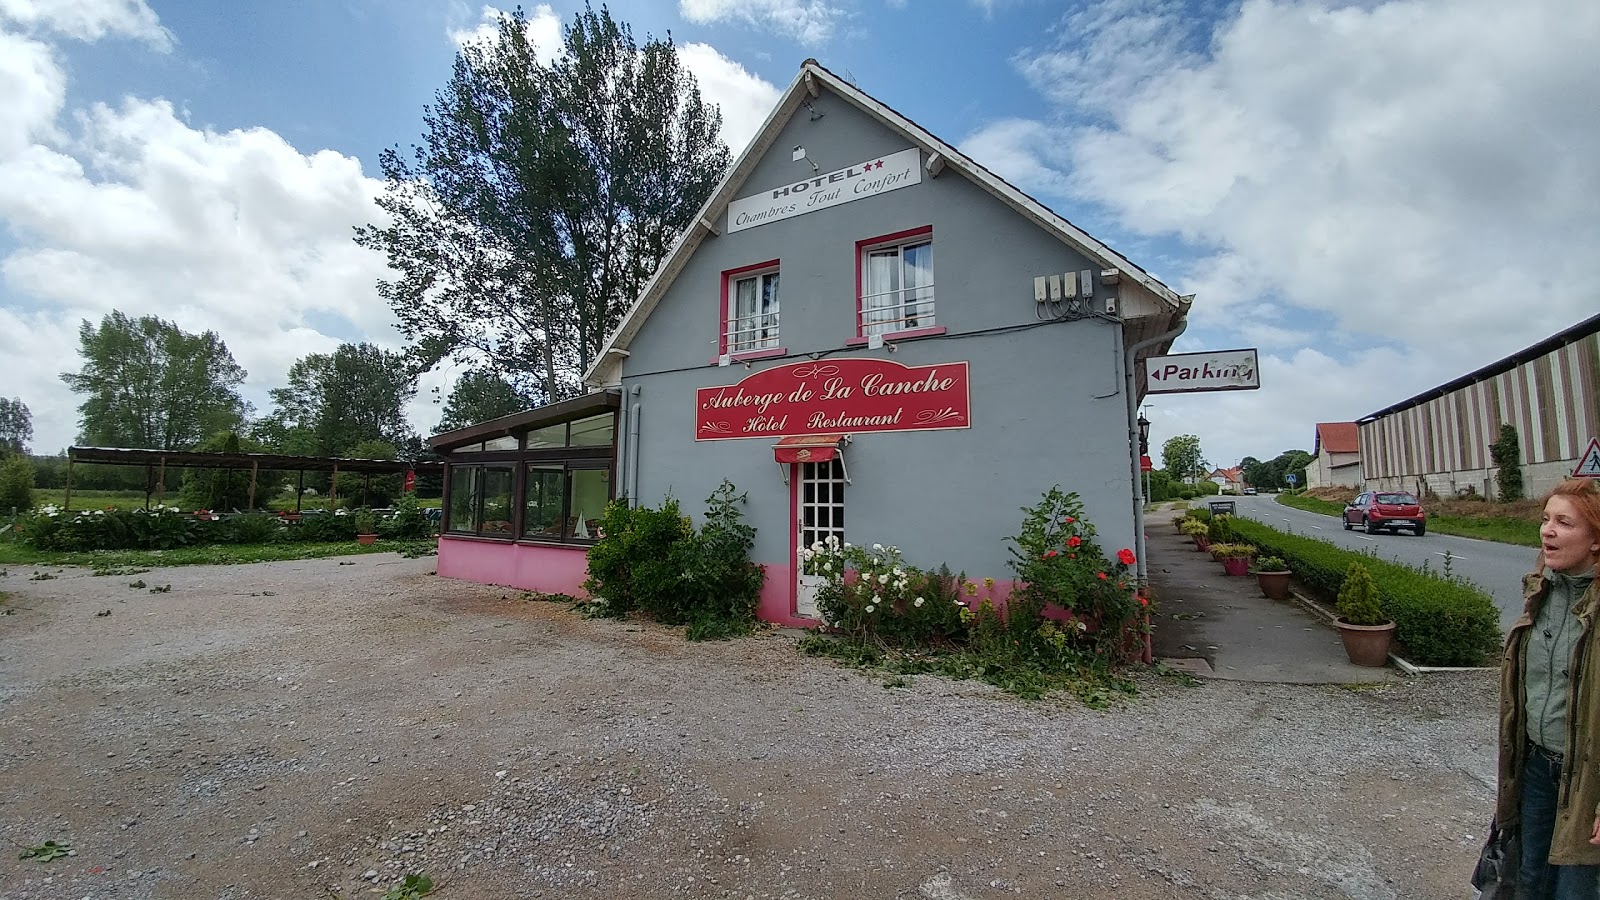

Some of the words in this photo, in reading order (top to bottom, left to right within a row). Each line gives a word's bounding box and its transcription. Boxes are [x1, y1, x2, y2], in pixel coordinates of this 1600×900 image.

[735, 203, 797, 226] Chambres
[807, 187, 841, 207] Tout
[853, 168, 911, 194] Confort
[772, 169, 863, 200] HOTEL
[702, 387, 788, 414] Auberge
[788, 382, 817, 403] de
[819, 377, 856, 400] La
[860, 369, 959, 396] Canche
[742, 414, 788, 433] Hôtel
[806, 407, 903, 429] Restaurant
